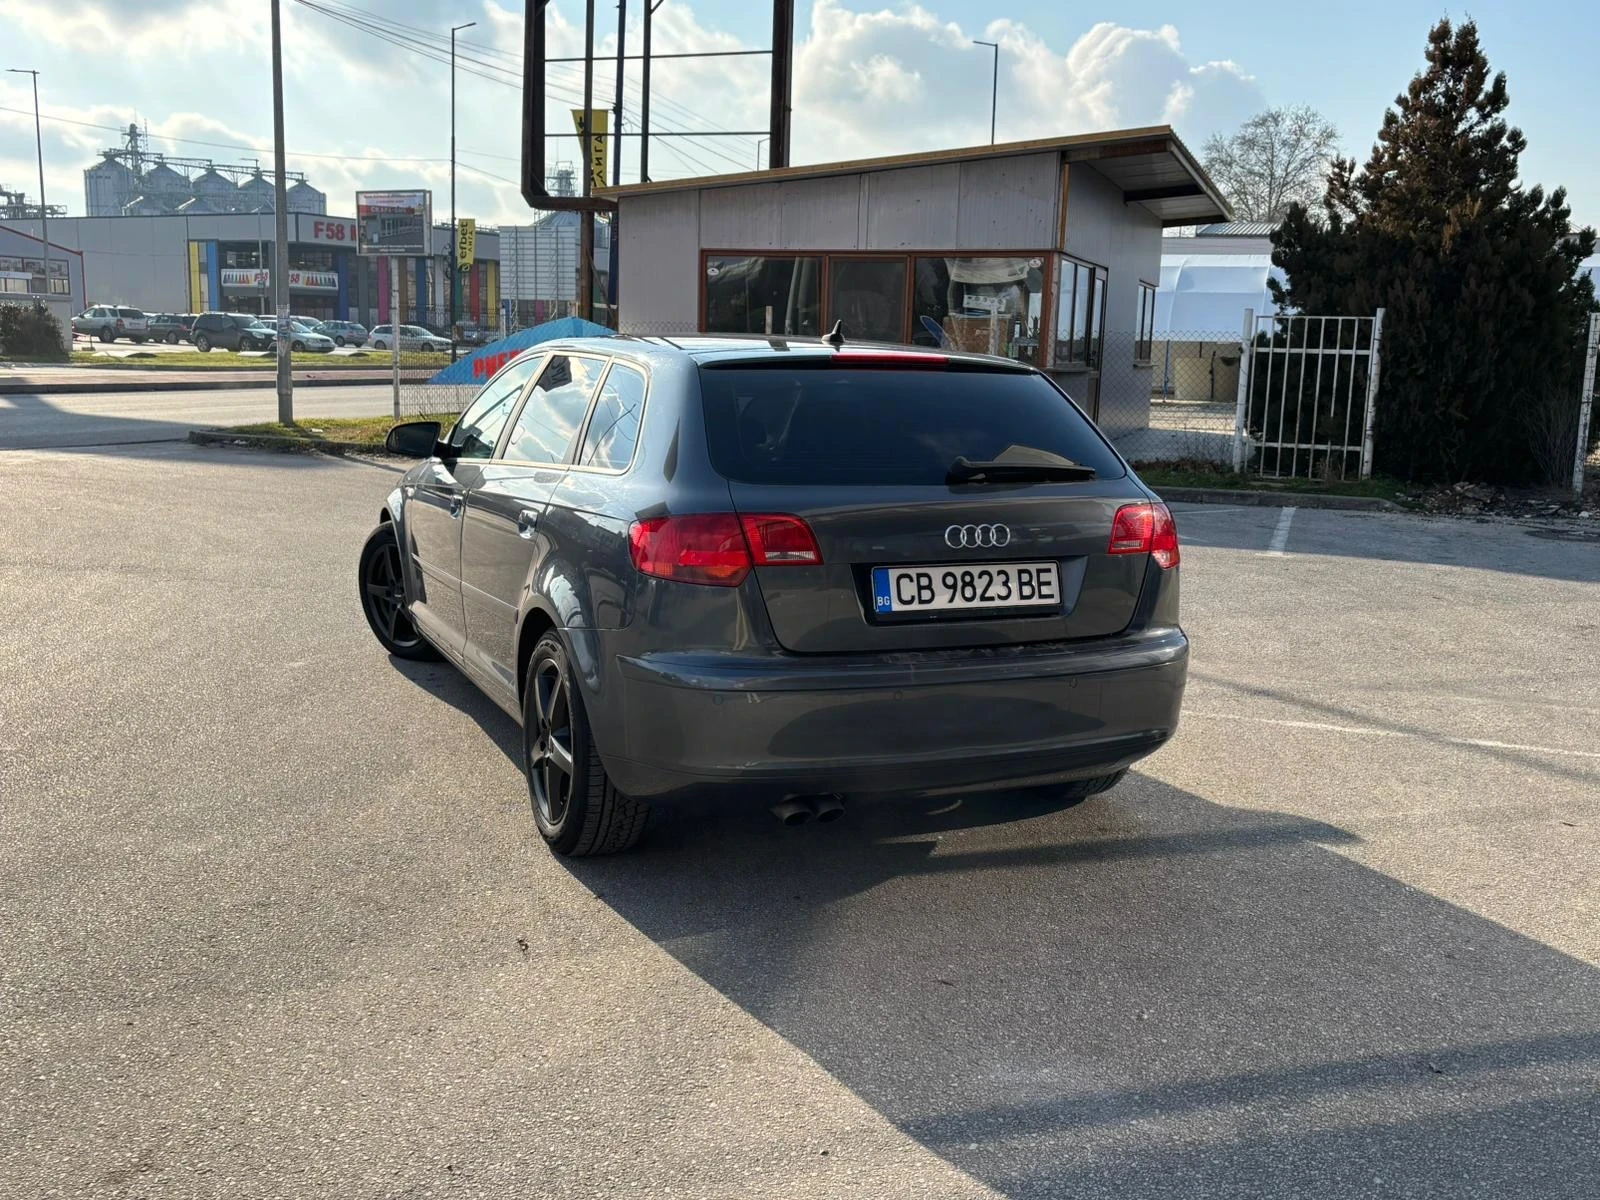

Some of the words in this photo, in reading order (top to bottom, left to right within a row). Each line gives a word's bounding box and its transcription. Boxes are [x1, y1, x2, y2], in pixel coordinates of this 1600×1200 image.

[314, 221, 345, 241] F58
[459, 221, 468, 259] efbet
[896, 573, 935, 605] CB
[942, 569, 1012, 603] 9823
[1017, 568, 1054, 600] BE
[877, 596, 890, 606] BG
